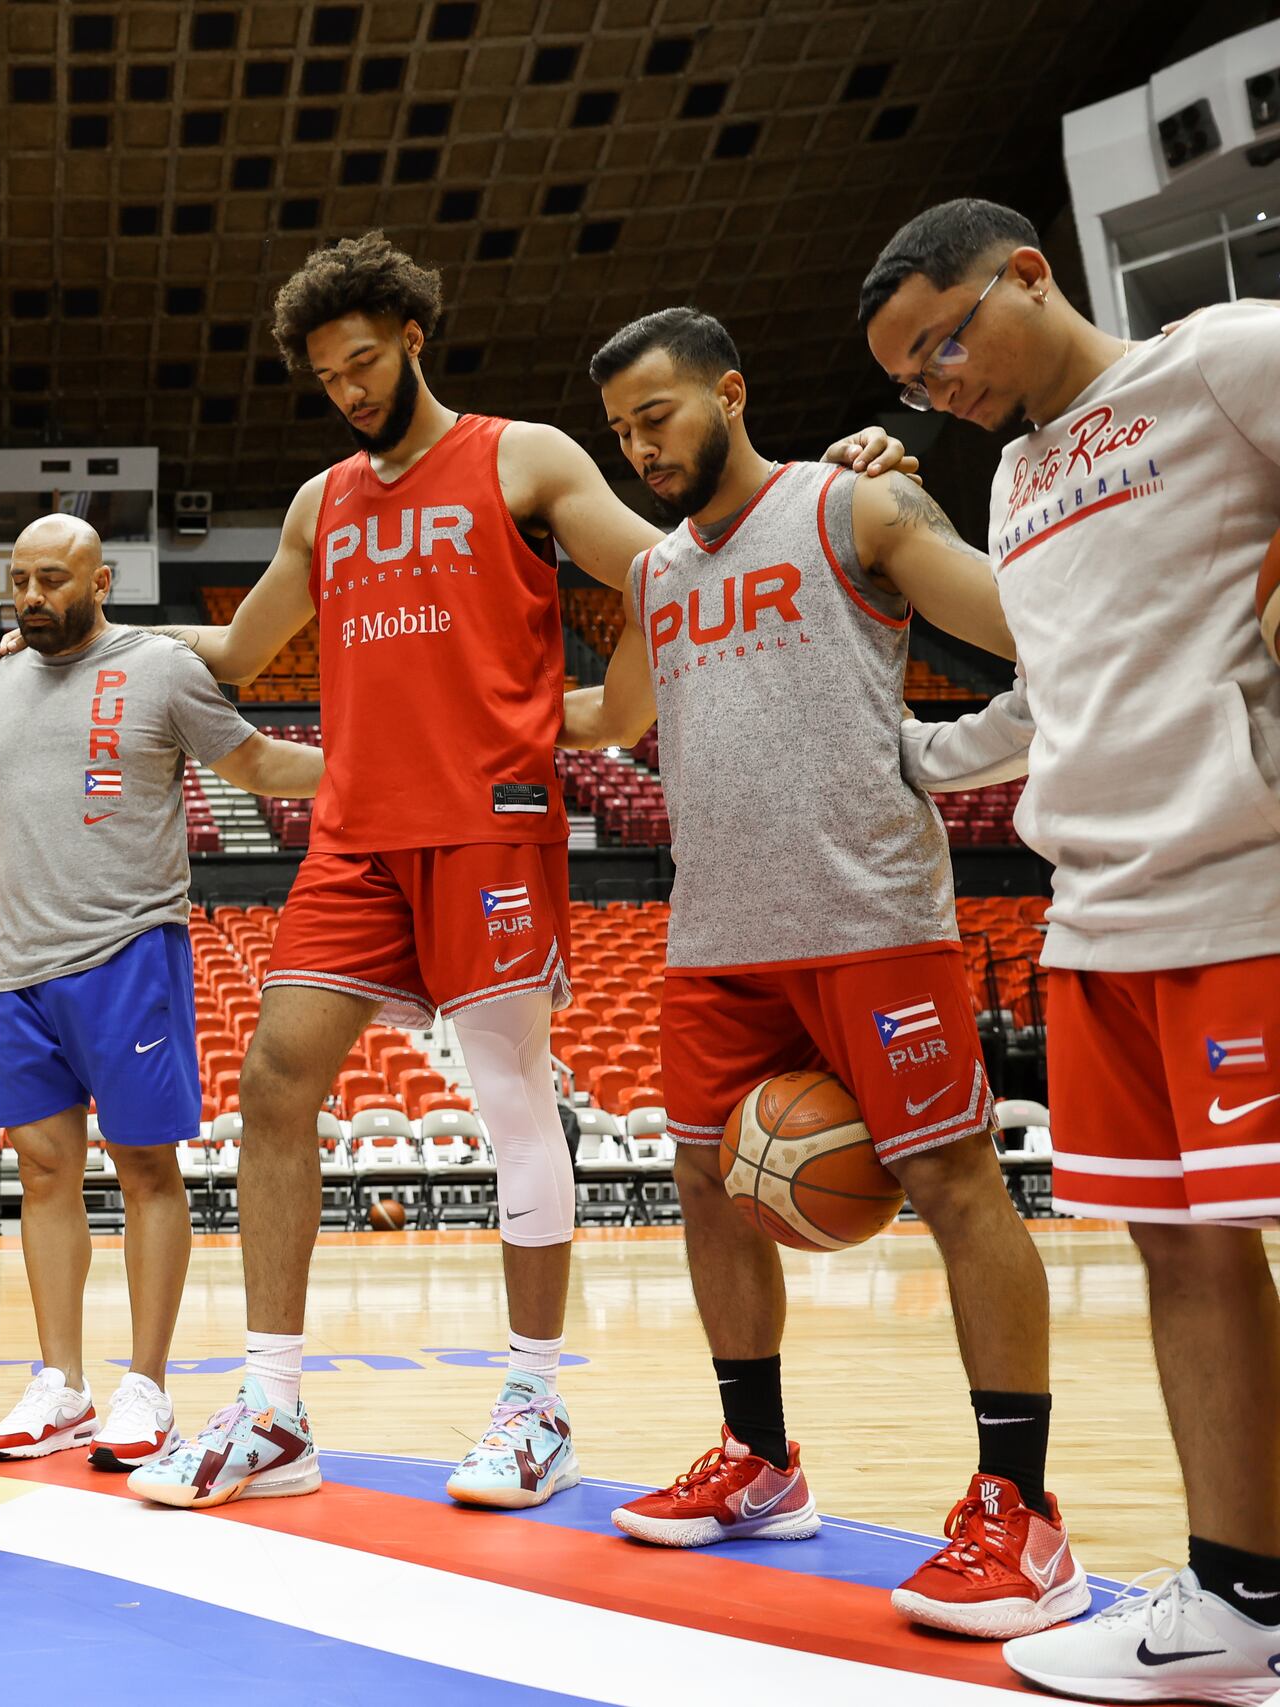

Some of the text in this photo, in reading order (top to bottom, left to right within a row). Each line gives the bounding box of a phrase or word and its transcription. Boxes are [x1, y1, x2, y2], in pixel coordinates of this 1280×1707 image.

[1065, 405, 1156, 478] Rico
[325, 504, 474, 582] PUR
[322, 563, 478, 600] BASKETBALL
[360, 604, 451, 644] Mobile
[650, 562, 803, 670] PUR
[659, 632, 811, 687] ASKETBALL
[89, 669, 127, 760] PUR
[487, 915, 533, 937] PUR
[887, 1038, 950, 1071] PUR
